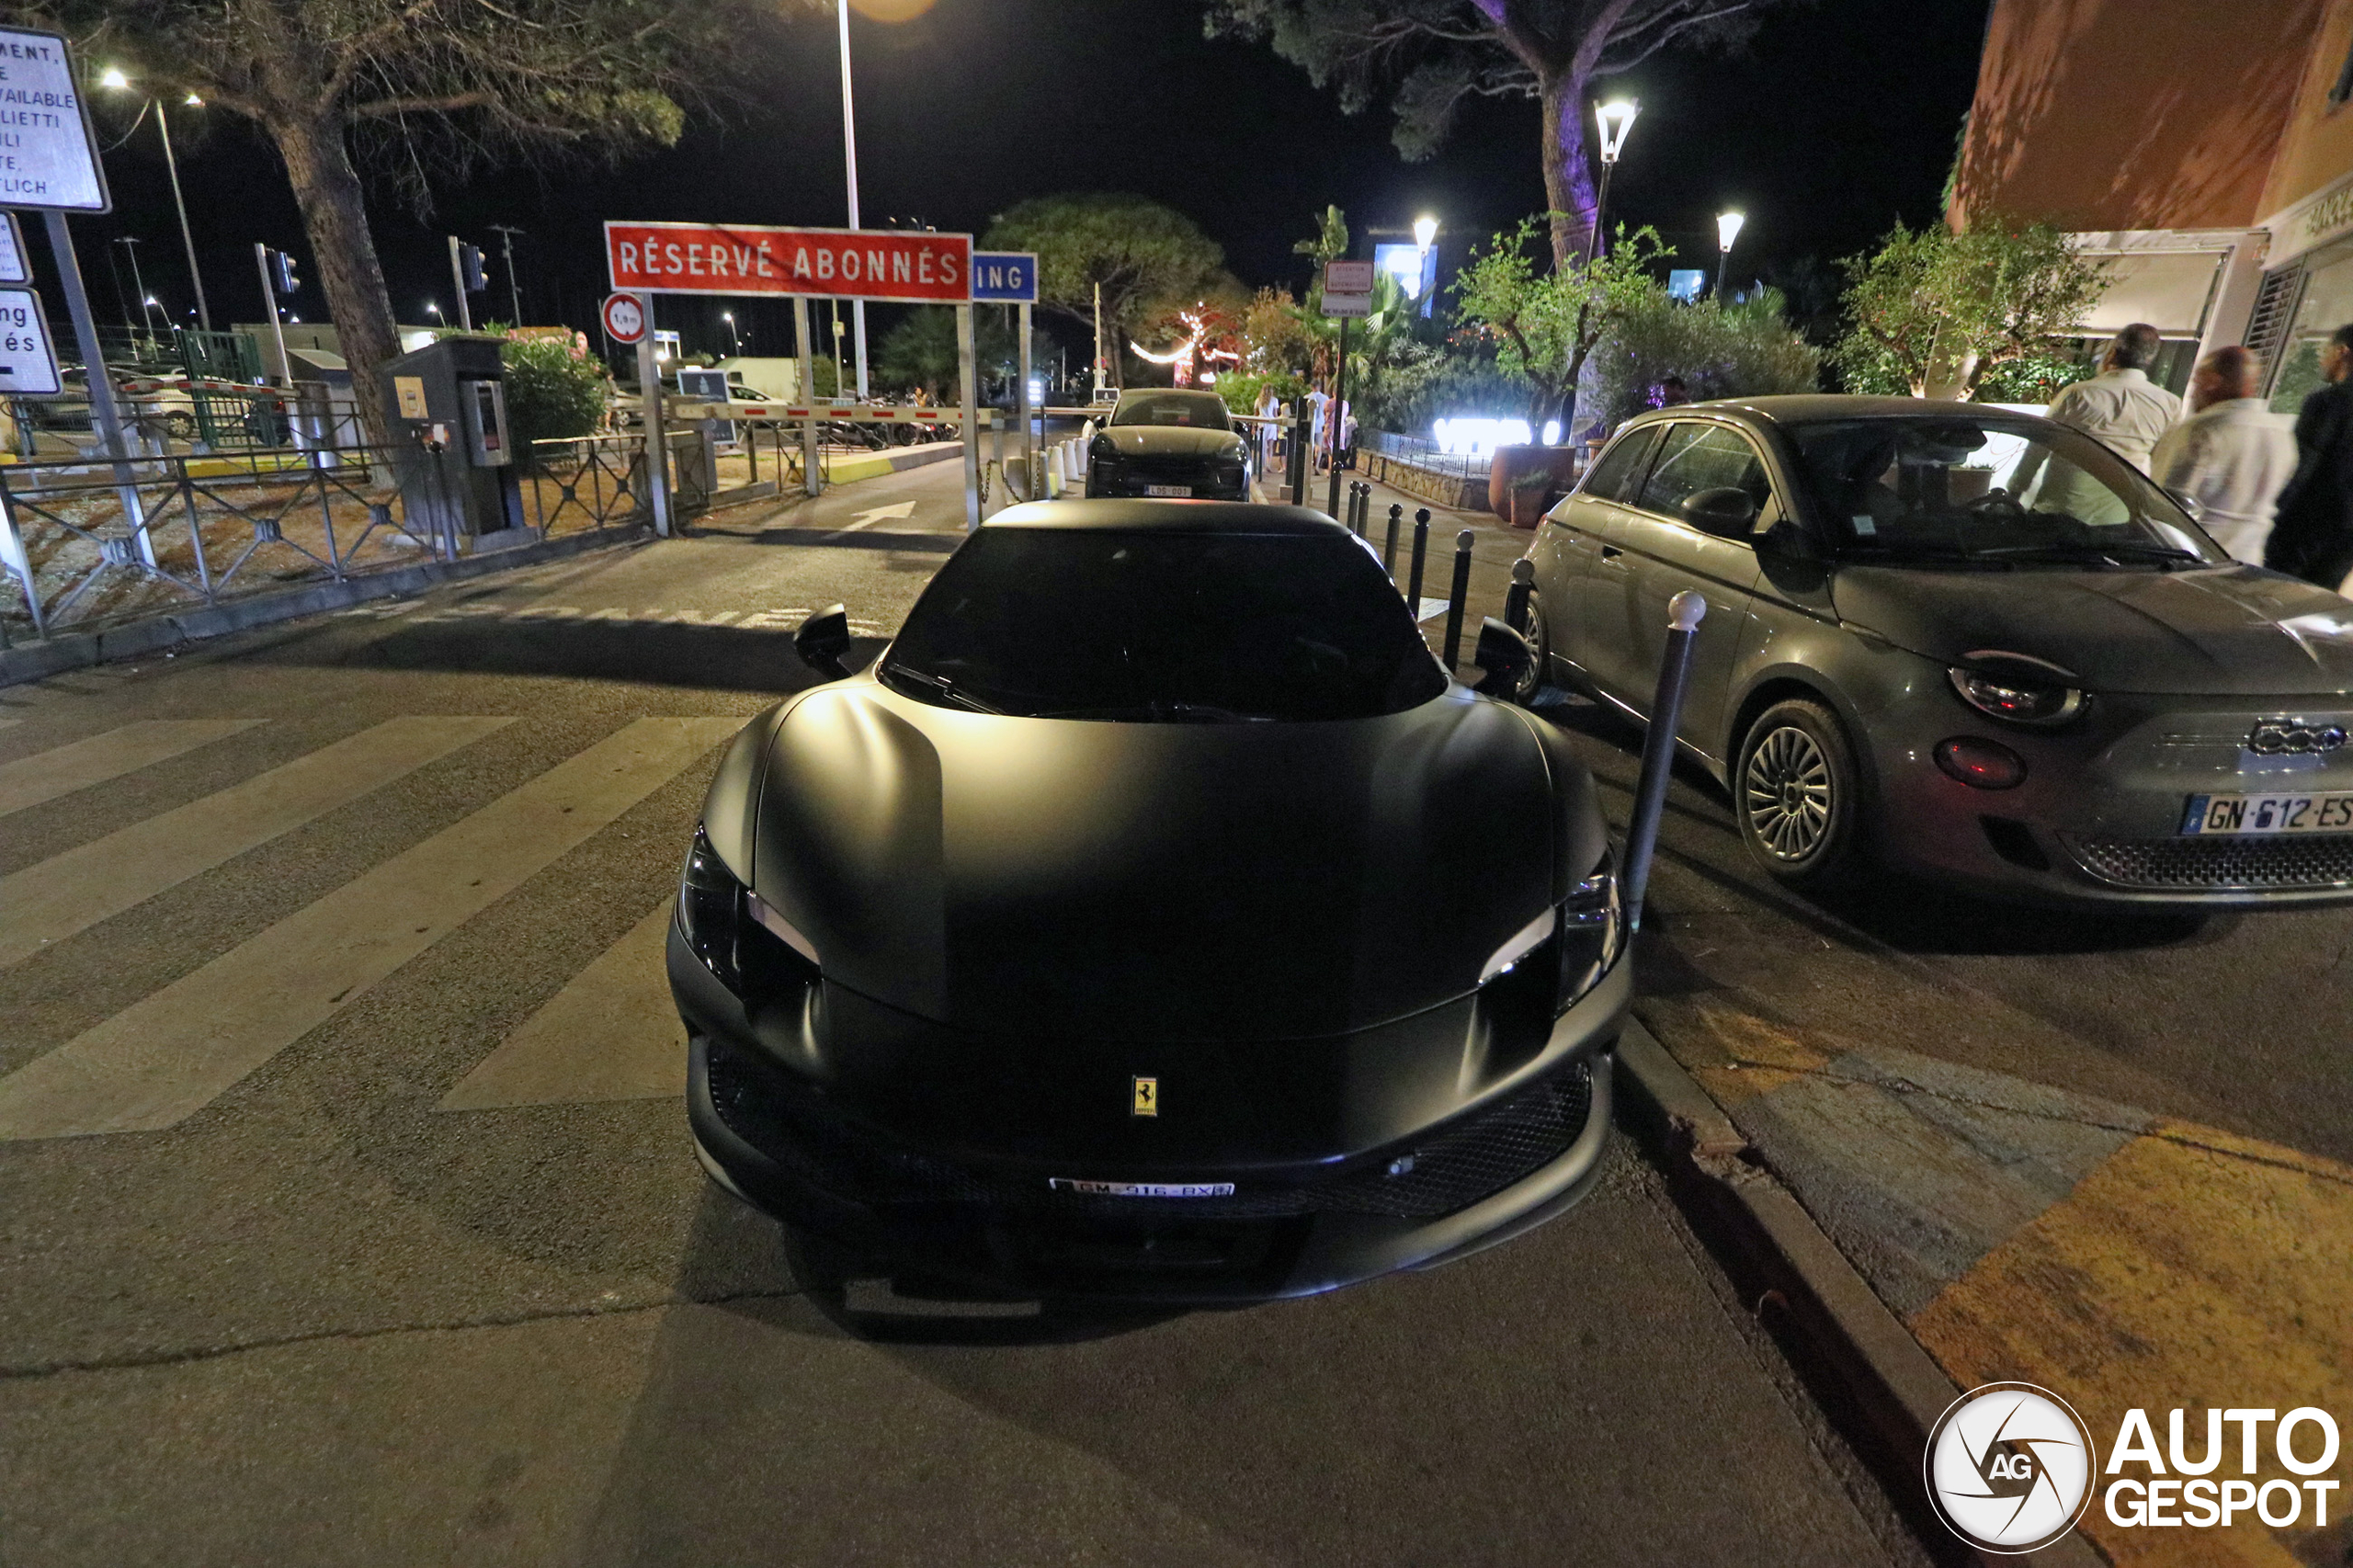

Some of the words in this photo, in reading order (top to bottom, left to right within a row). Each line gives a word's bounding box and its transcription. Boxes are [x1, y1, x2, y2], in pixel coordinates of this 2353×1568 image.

[0, 177, 47, 194] LICH
[620, 236, 773, 278] RÉSERVÉ
[793, 246, 958, 285] ABONNÉS
[976, 266, 1023, 290] ING
[6, 332, 34, 352] és
